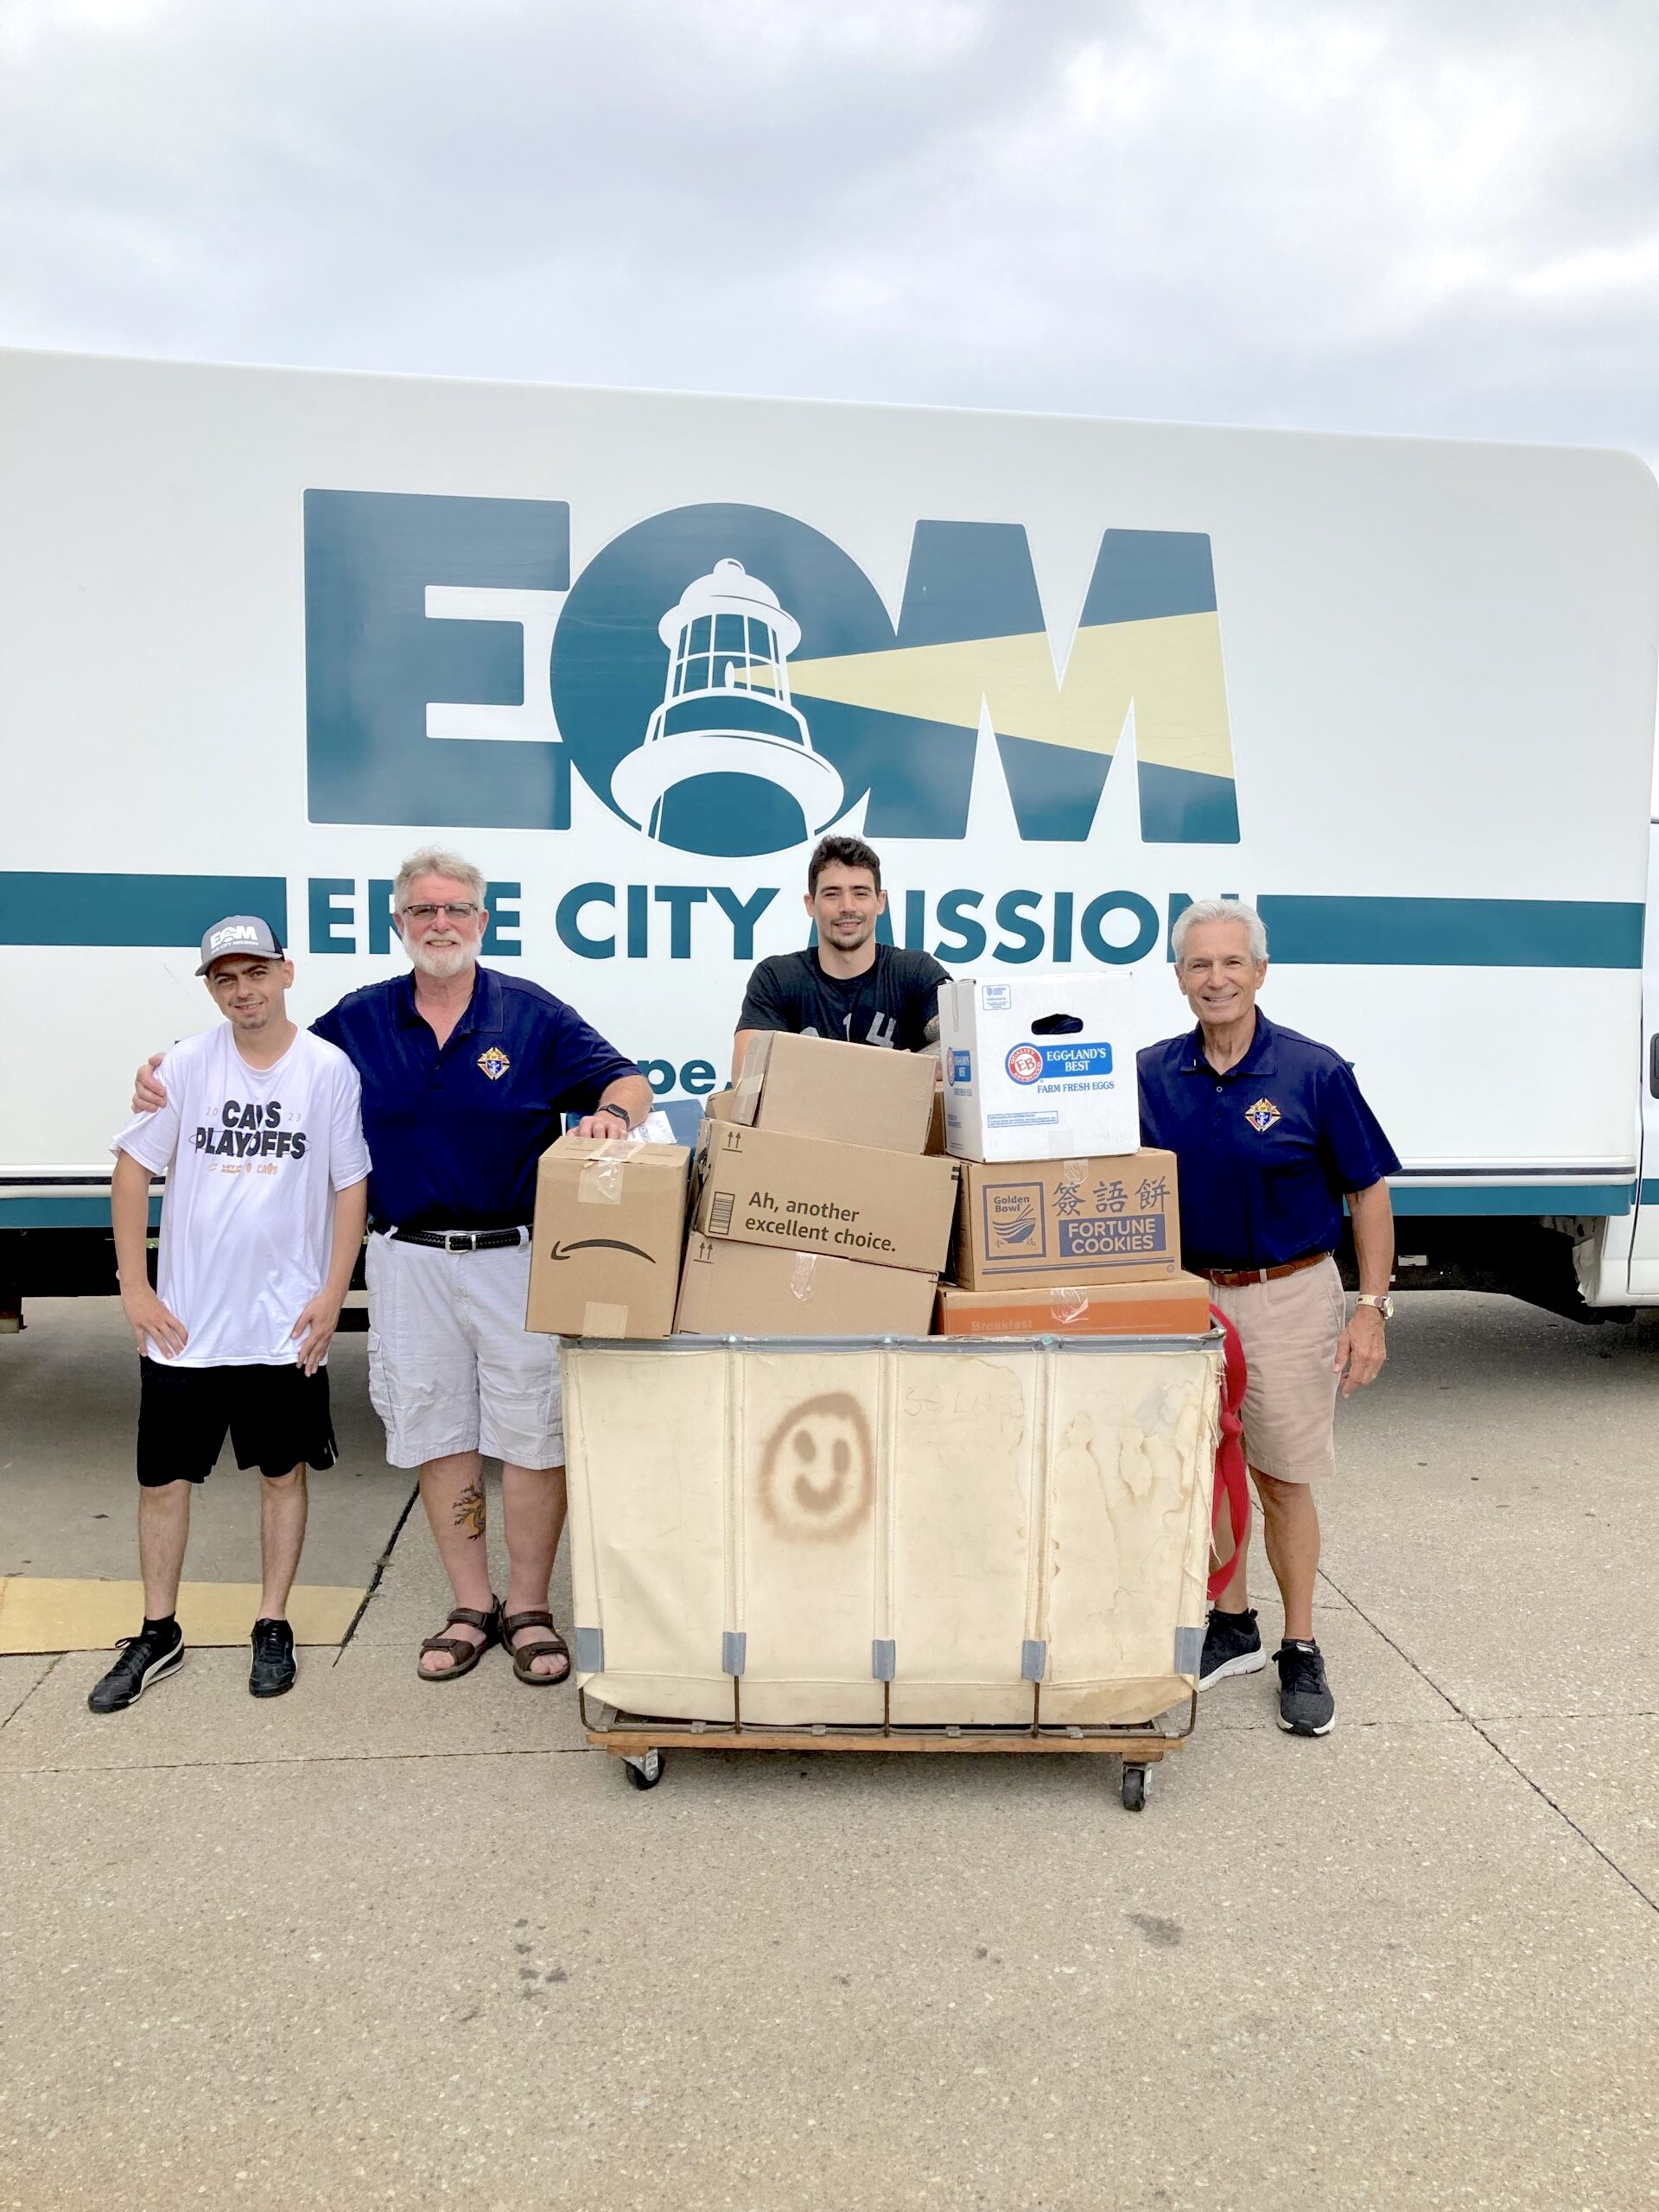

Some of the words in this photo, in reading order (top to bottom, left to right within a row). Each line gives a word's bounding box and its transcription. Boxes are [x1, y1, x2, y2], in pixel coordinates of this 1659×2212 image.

[308, 878, 521, 957] EE
[556, 881, 781, 961] CITY
[806, 888, 1239, 964] ISSIO
[1017, 1058, 1035, 1071] EB
[1065, 1060, 1090, 1072] BEST
[1037, 1084, 1061, 1094] FARM
[1063, 1083, 1090, 1092] FRESH
[1092, 1081, 1115, 1090] EGGS
[288, 1112, 302, 1122] 23
[194, 1127, 307, 1160] PLAYOFFS
[993, 1195, 1030, 1205] Golden
[748, 1192, 779, 1213] Ah,
[785, 1199, 860, 1223] another
[995, 1204, 1021, 1213] Bowl
[1068, 1217, 1156, 1238] FORTUNE
[745, 1217, 830, 1242] excellent
[834, 1228, 896, 1252] choice.
[1071, 1235, 1154, 1255] COOKIES
[971, 1319, 1033, 1332] Breakfast
